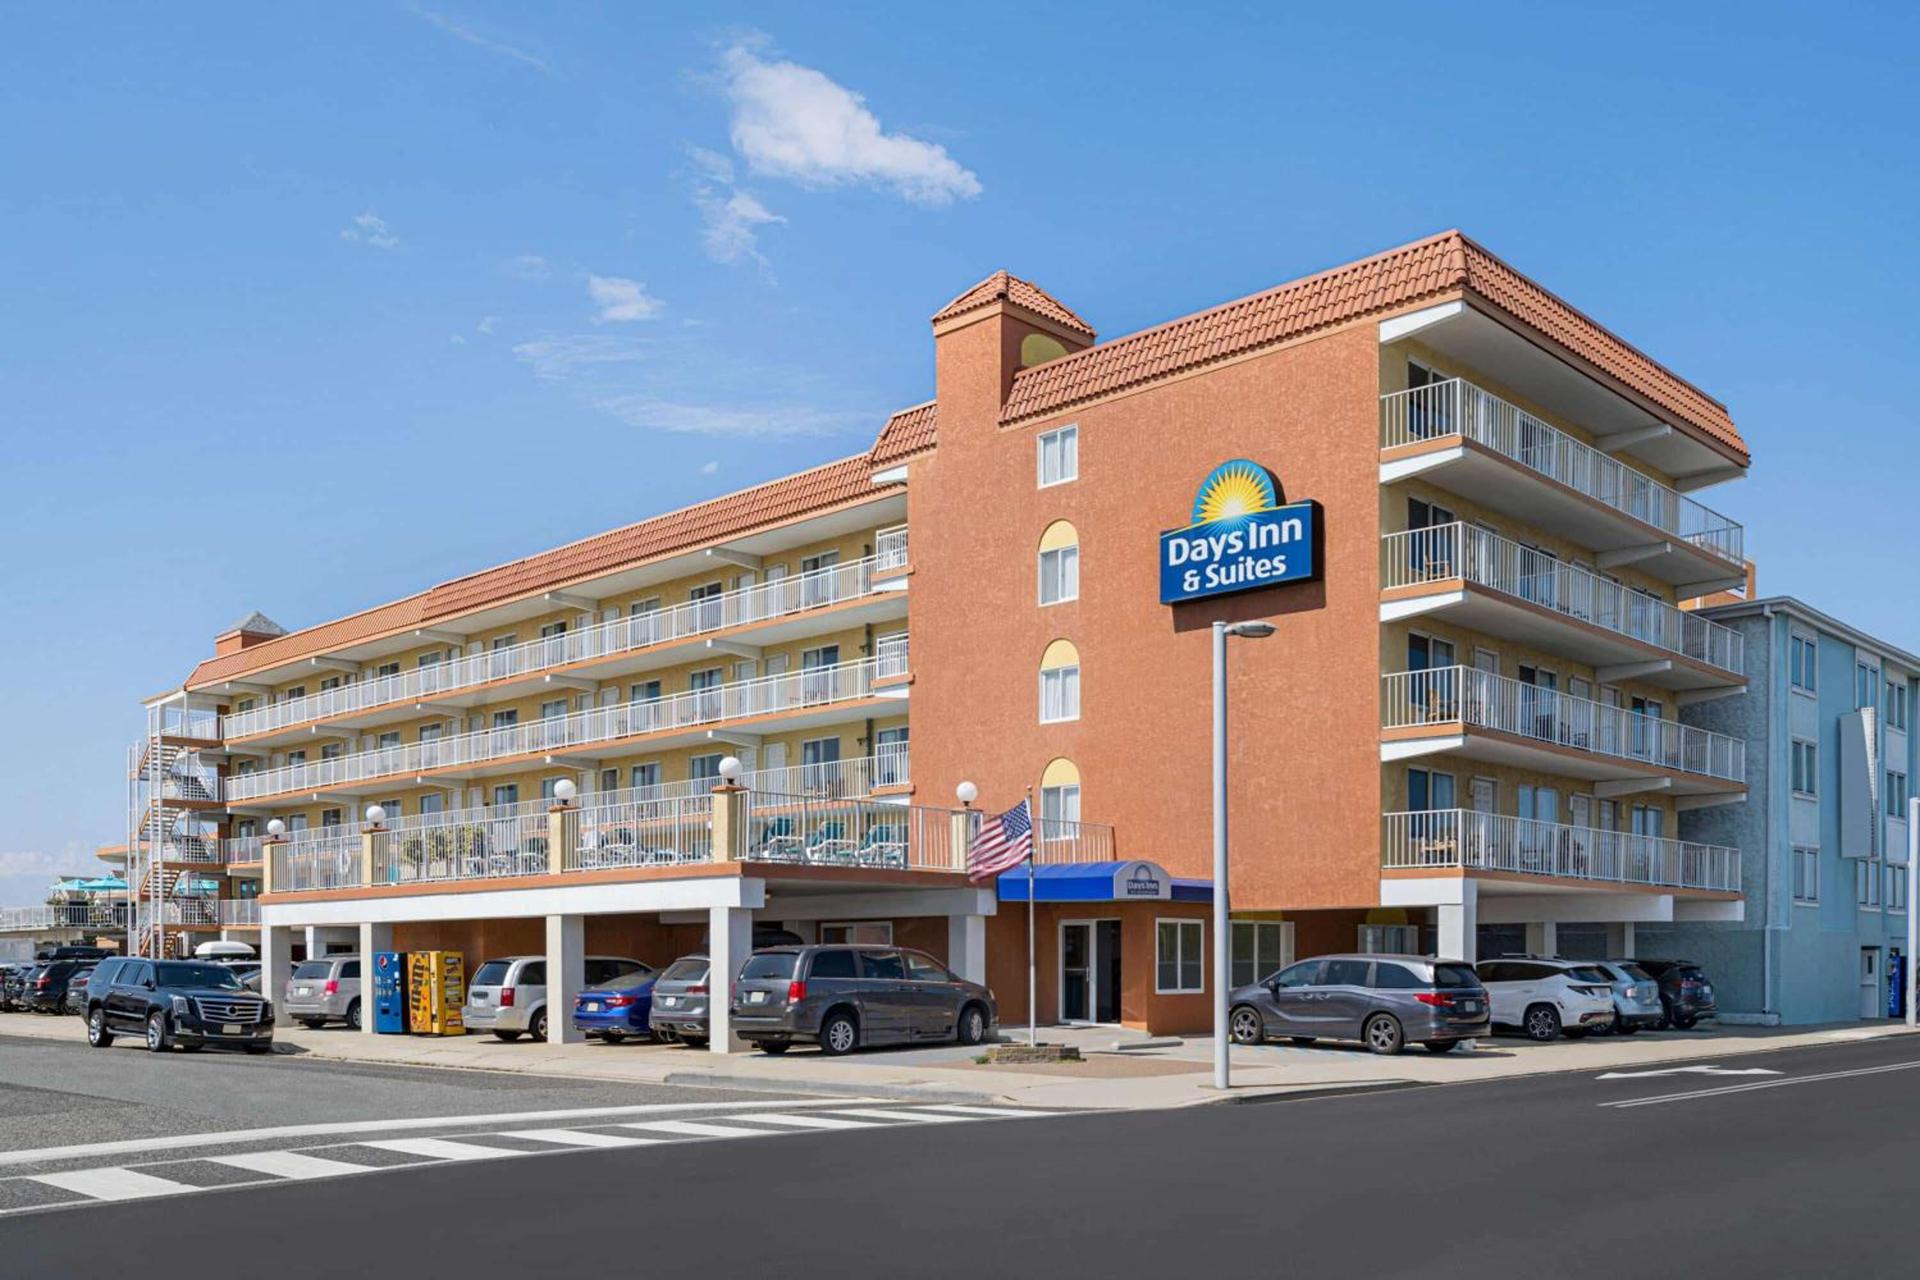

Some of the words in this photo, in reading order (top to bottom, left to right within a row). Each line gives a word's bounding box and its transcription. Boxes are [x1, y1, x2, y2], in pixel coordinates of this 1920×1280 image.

[1169, 531, 1243, 566] Days
[1249, 518, 1302, 550] Inn
[1183, 570, 1200, 592] &
[1205, 555, 1287, 588] Suites
